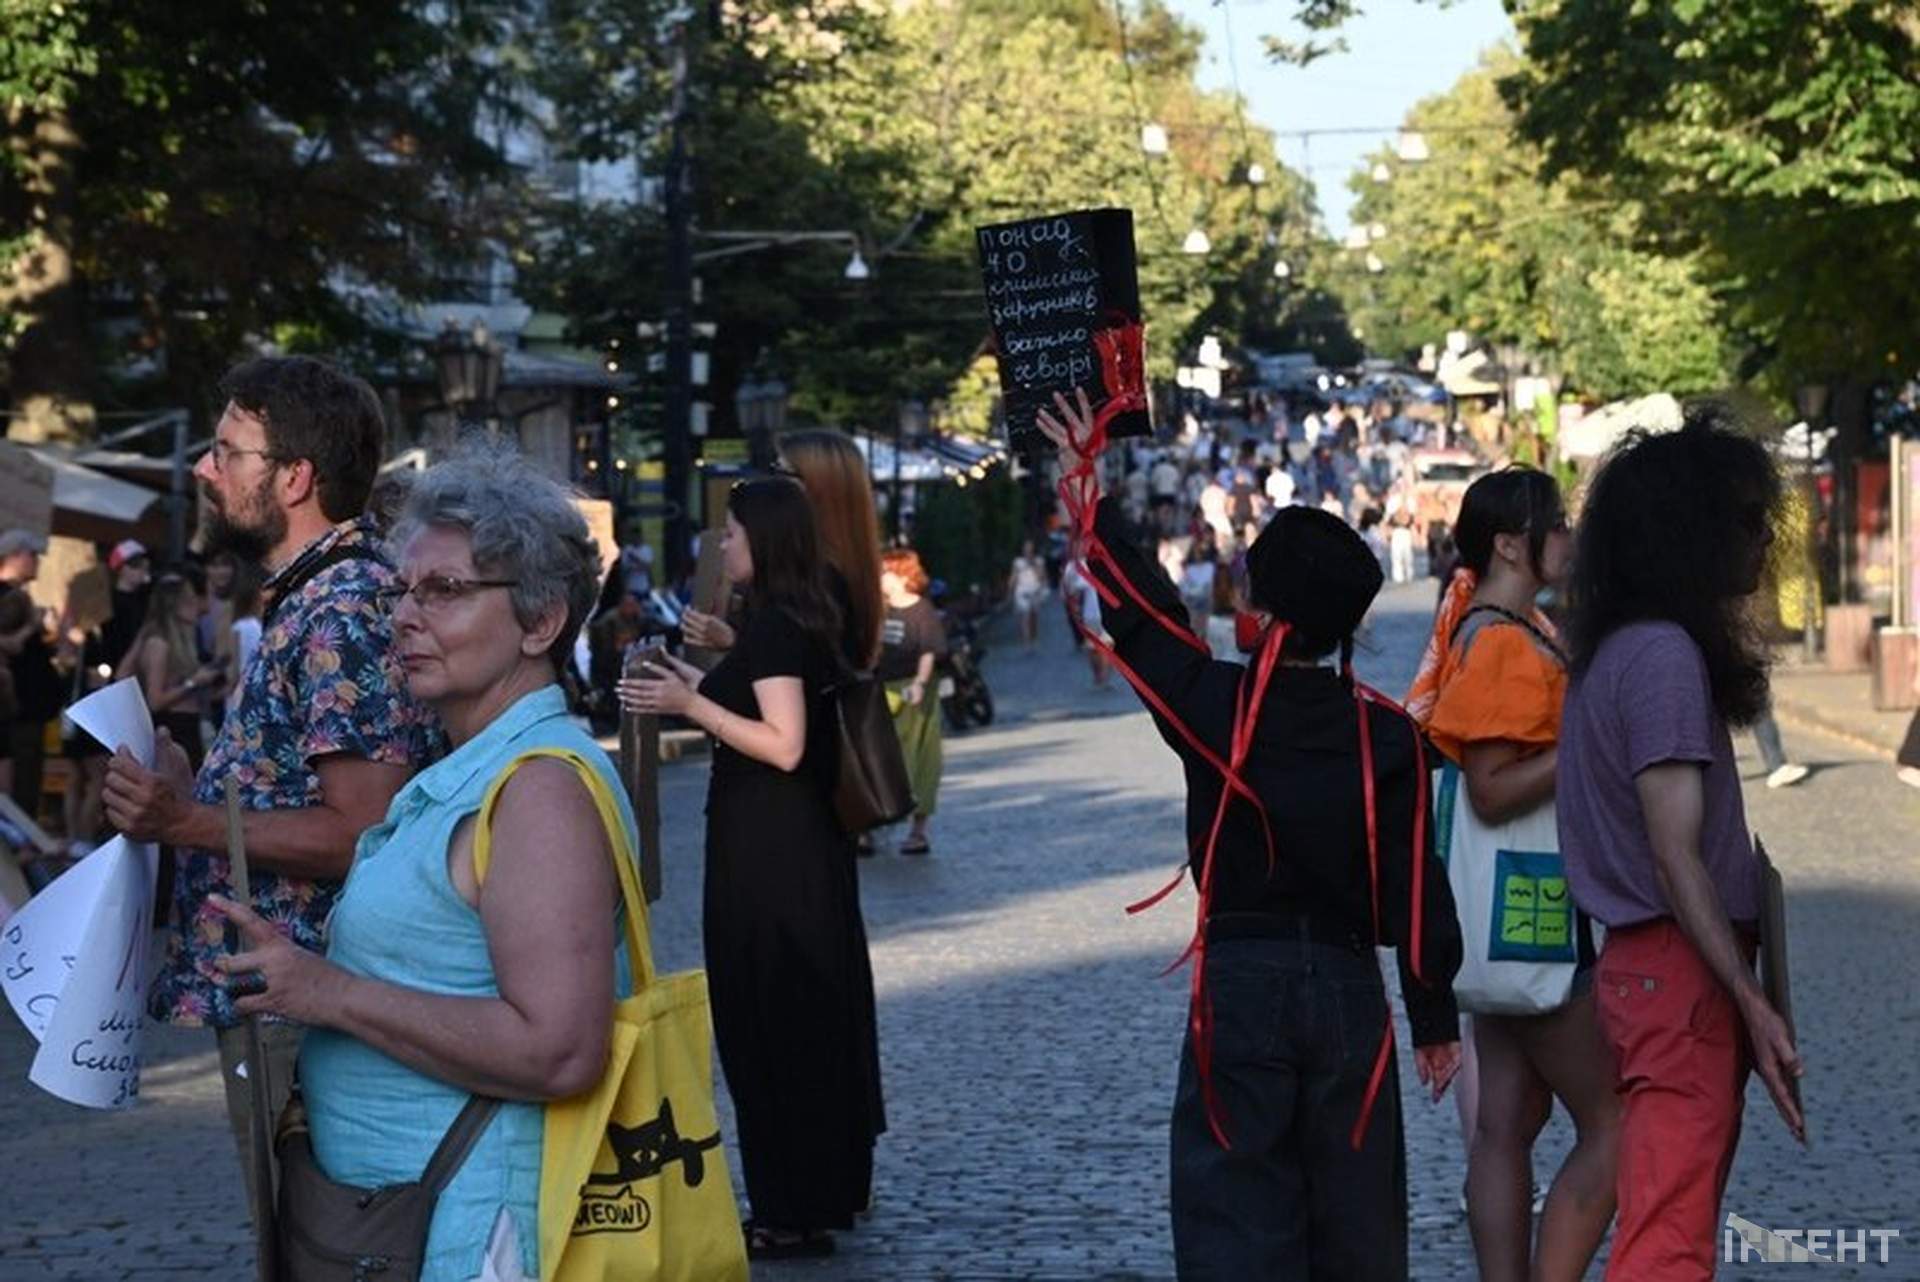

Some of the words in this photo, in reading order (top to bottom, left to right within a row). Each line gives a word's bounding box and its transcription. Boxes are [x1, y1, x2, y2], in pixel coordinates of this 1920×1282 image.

[987, 251, 1026, 273] 40
[1004, 328, 1087, 354] важко
[1014, 350, 1092, 387] хворі
